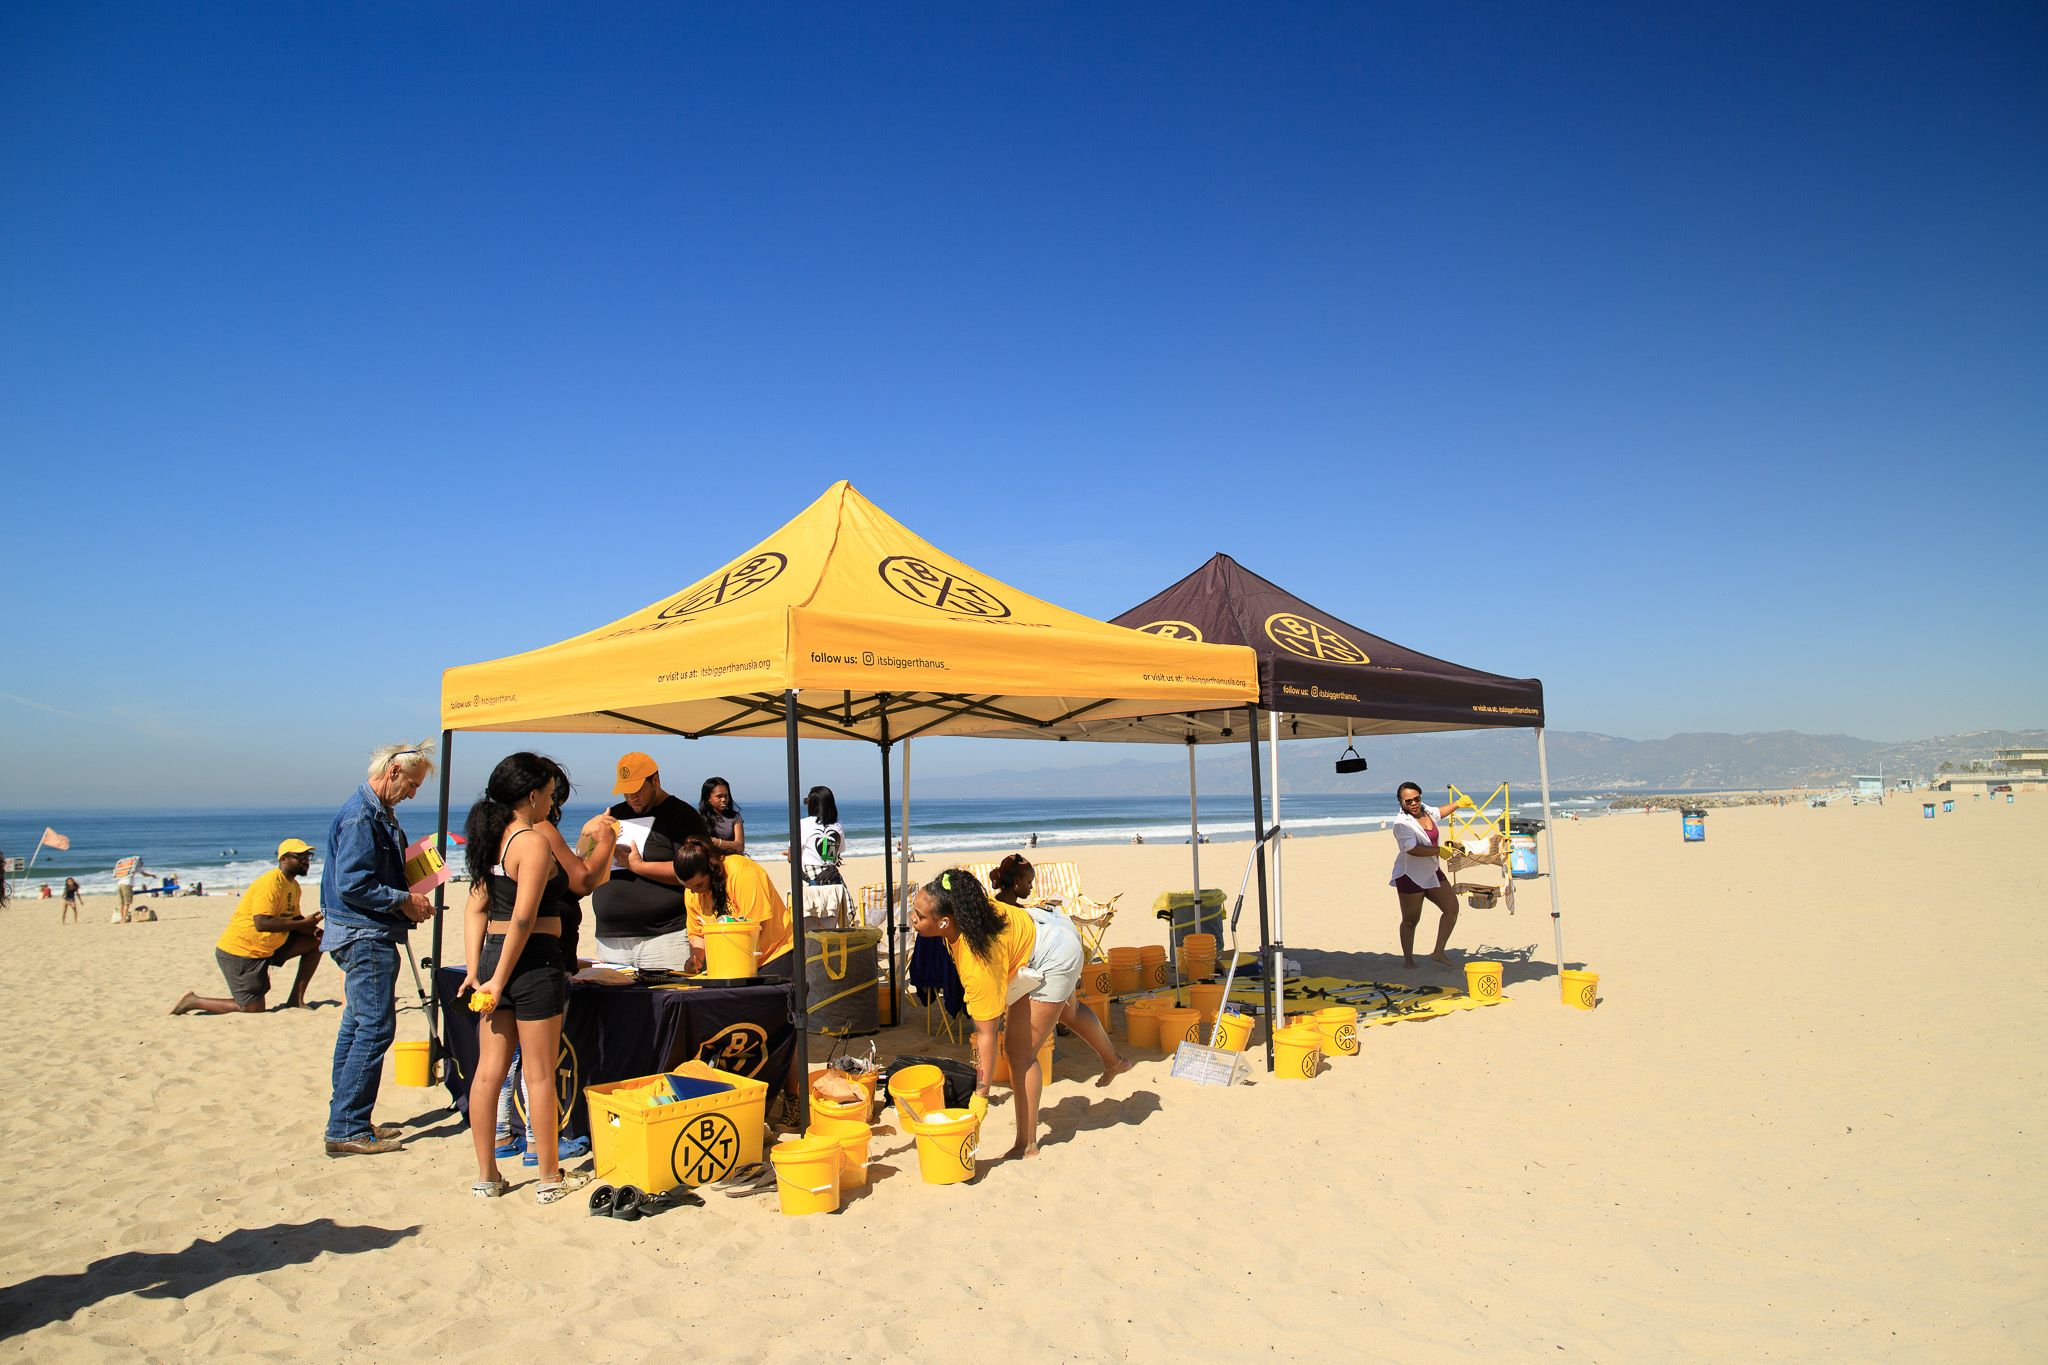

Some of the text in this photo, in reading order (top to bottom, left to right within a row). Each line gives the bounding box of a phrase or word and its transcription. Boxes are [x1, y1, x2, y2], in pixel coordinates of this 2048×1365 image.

[811, 652, 842, 664] follow
[844, 654, 858, 665] us:
[658, 659, 771, 683] or visit us at: itsbiggerthanusla.org
[1151, 673, 1165, 682] visit
[1283, 685, 1301, 695] follow
